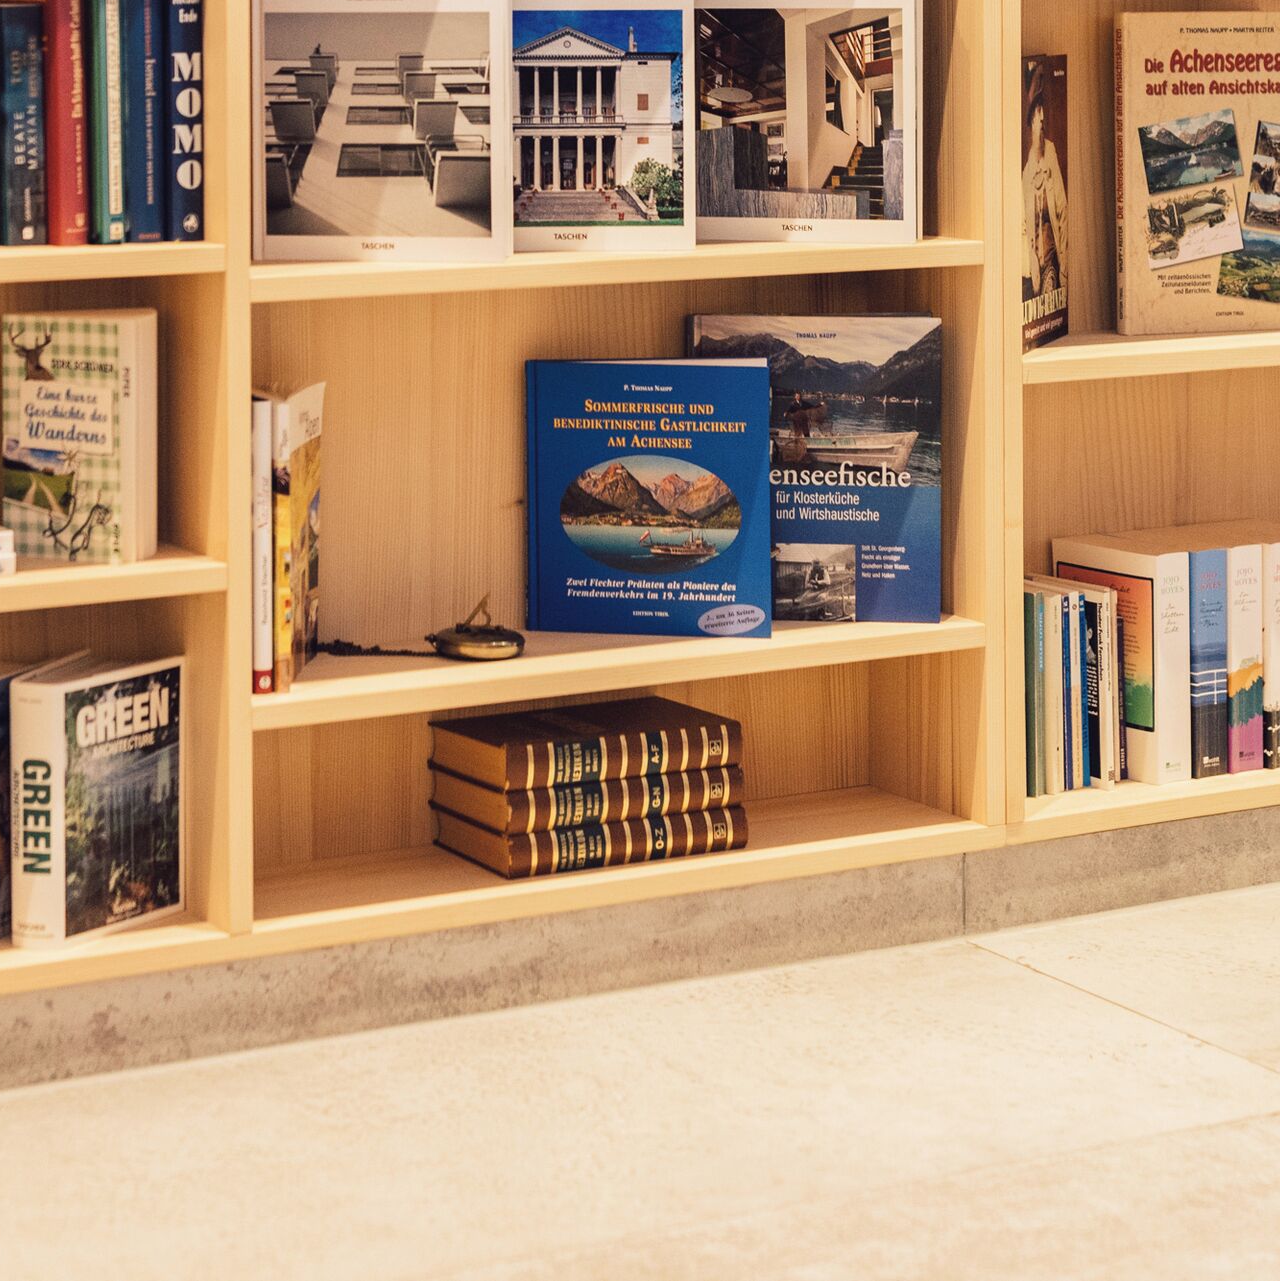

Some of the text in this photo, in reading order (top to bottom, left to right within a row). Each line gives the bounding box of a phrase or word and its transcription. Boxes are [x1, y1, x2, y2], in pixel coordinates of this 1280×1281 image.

[1144, 58, 1164, 73] Die
[1145, 80, 1167, 96] auf
[1172, 80, 1205, 95] alten
[1115, 95, 1123, 117] alten
[13, 110, 26, 166] BEATE
[27, 104, 38, 170] MAXIAN
[780, 223, 813, 232] TASCHEN
[553, 232, 588, 241] TASCHEN
[361, 242, 395, 251] TASCHEN
[37, 386, 61, 400] Eine
[25, 403, 108, 423] Geschichte des
[585, 399, 714, 415] SOMMERFRISCHE UND
[26, 421, 107, 445] Wanderns
[552, 417, 747, 433] BENEDIKTINISCHE GASTLICHKEIT
[608, 434, 692, 449] AM ACHENSEE
[769, 460, 911, 487] enseefische
[776, 491, 859, 505] für Klosterküche
[776, 507, 880, 521] und Wirtshaustische
[878, 545, 905, 553] Georgenberg
[566, 578, 587, 586] Zwei
[627, 579, 665, 590] Prälaten
[667, 580, 681, 590] als
[683, 581, 719, 591] Pioniere
[722, 582, 737, 591] des
[567, 588, 736, 602] Fremdenverkehrs 19. Jahrhundert
[75, 687, 170, 749] GREEN
[92, 734, 155, 759] ARCHITECTURE
[651, 744, 660, 764] A-F
[652, 787, 661, 808] G-N
[22, 758, 52, 875] GREEN
[655, 828, 664, 850] O-Z
